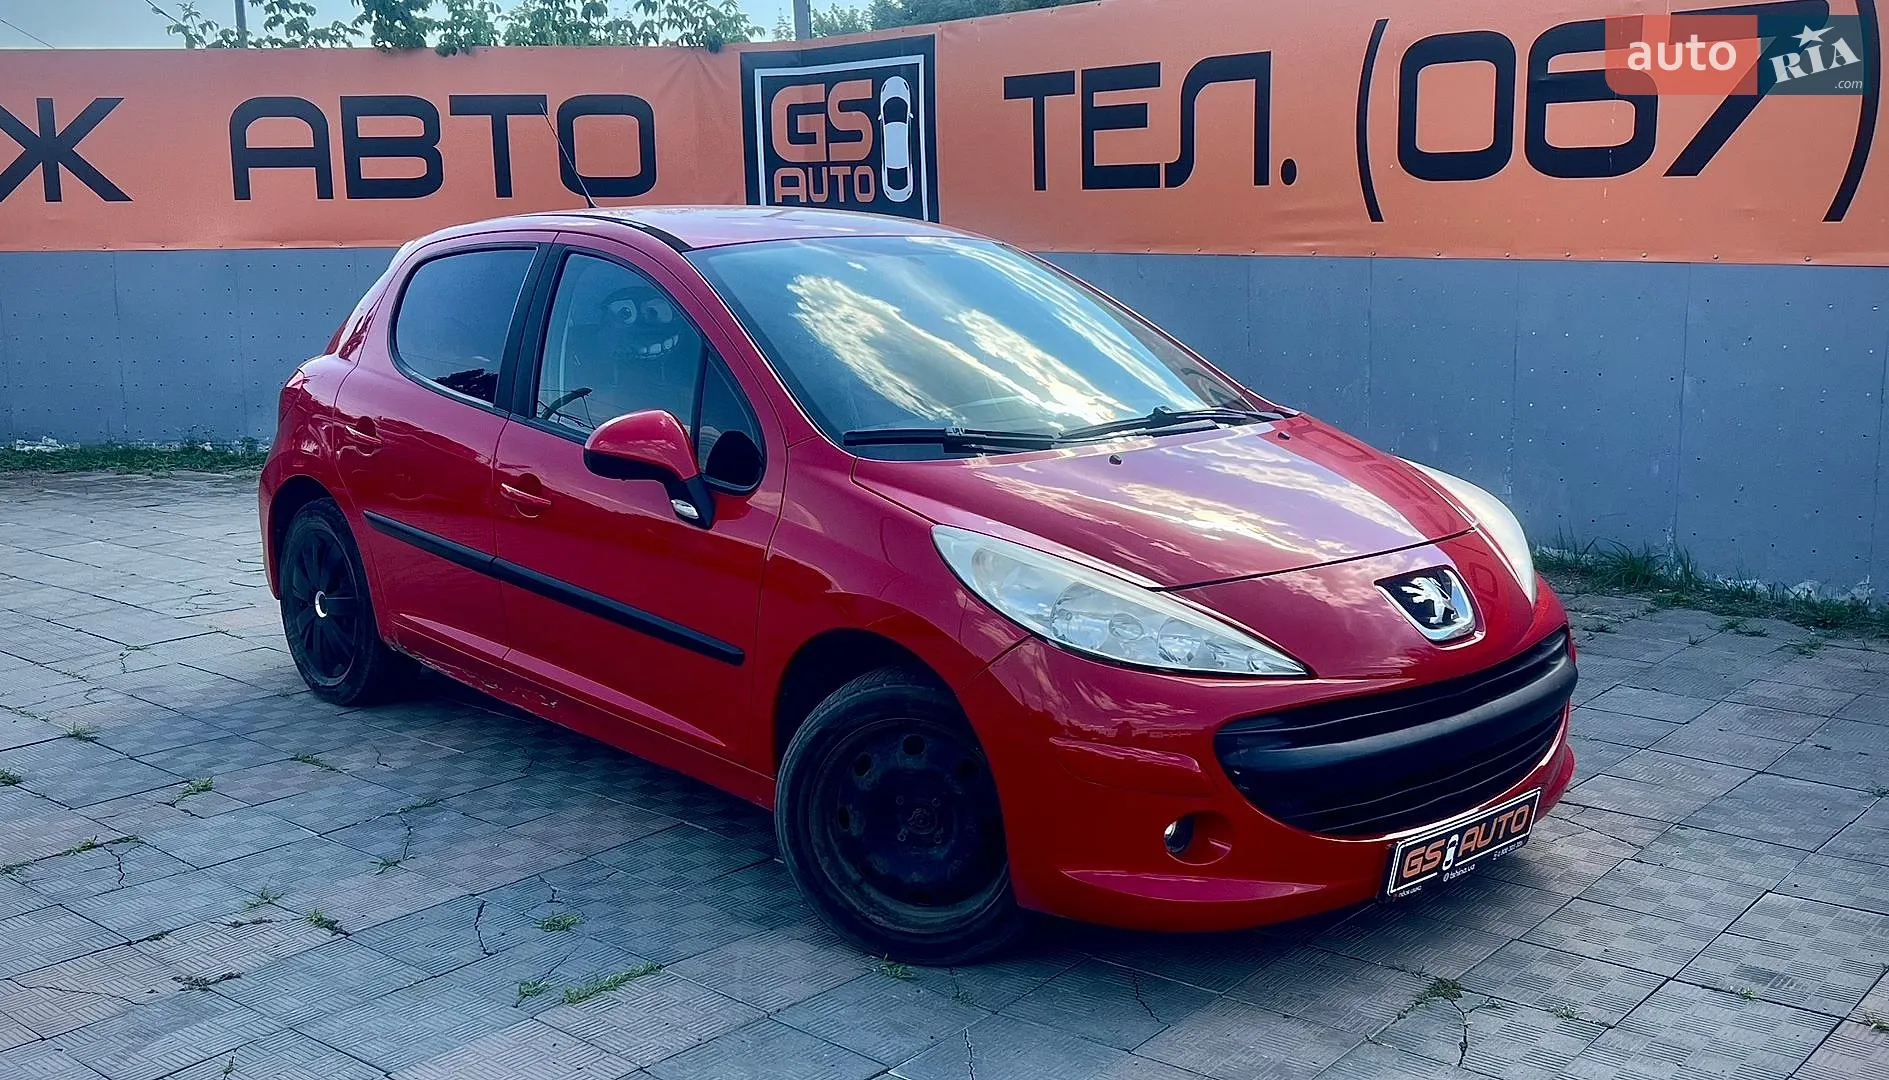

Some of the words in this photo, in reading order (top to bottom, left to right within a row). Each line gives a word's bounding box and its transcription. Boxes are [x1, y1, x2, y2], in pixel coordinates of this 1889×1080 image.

[229, 94, 656, 200] АВТО
[771, 79, 873, 162] GS
[1003, 50, 1298, 191] ТЕЛ.
[774, 165, 875, 202] AUTO
[1402, 839, 1446, 879] GS
[1458, 804, 1530, 857] AUTO
